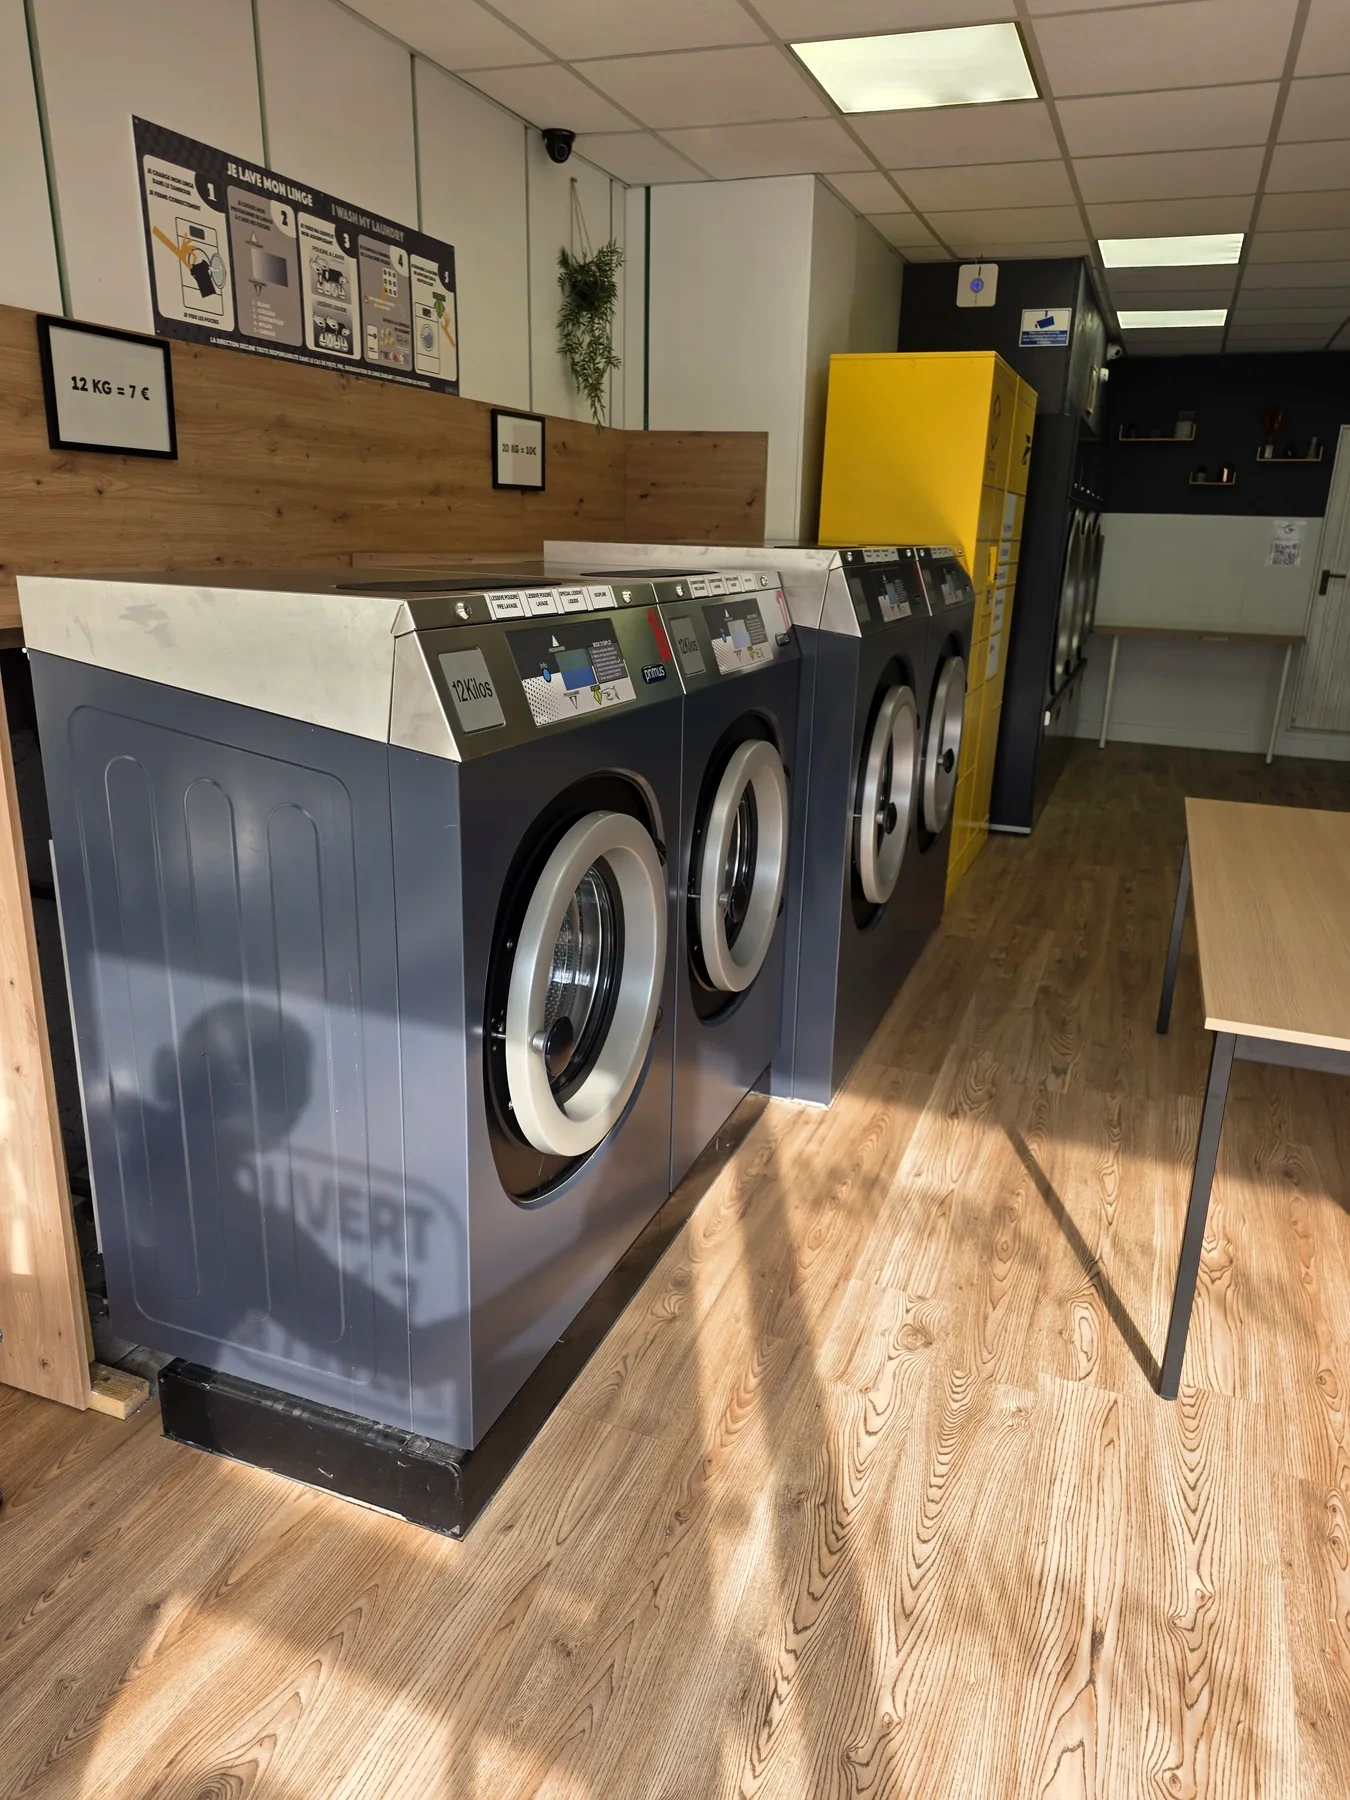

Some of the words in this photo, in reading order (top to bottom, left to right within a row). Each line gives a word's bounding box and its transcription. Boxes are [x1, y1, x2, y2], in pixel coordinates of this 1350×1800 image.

[207, 183, 217, 202] 1
[227, 162, 237, 178] JE
[238, 166, 262, 187] LAVE
[263, 176, 286, 196] MON
[287, 186, 313, 207] LINGE
[281, 210, 289, 227] 2
[331, 203, 336, 216] I
[335, 205, 359, 225] WASH
[358, 215, 371, 230] MY
[371, 220, 404, 242] LAUNDRY
[343, 233, 351, 249] 3
[398, 254, 404, 268] 4
[210, 336, 217, 344] LA
[216, 338, 240, 348] DIRECTION
[71, 375, 89, 392] 12
[92, 378, 112, 395] KG
[117, 387, 125, 396] =
[129, 385, 137, 399] 7
[141, 387, 150, 400] €
[502, 443, 510, 453] 20
[511, 444, 520, 454] KG
[525, 446, 537, 456] 10€
[643, 664, 665, 683] primus
[451, 677, 494, 703] 12Kilos
